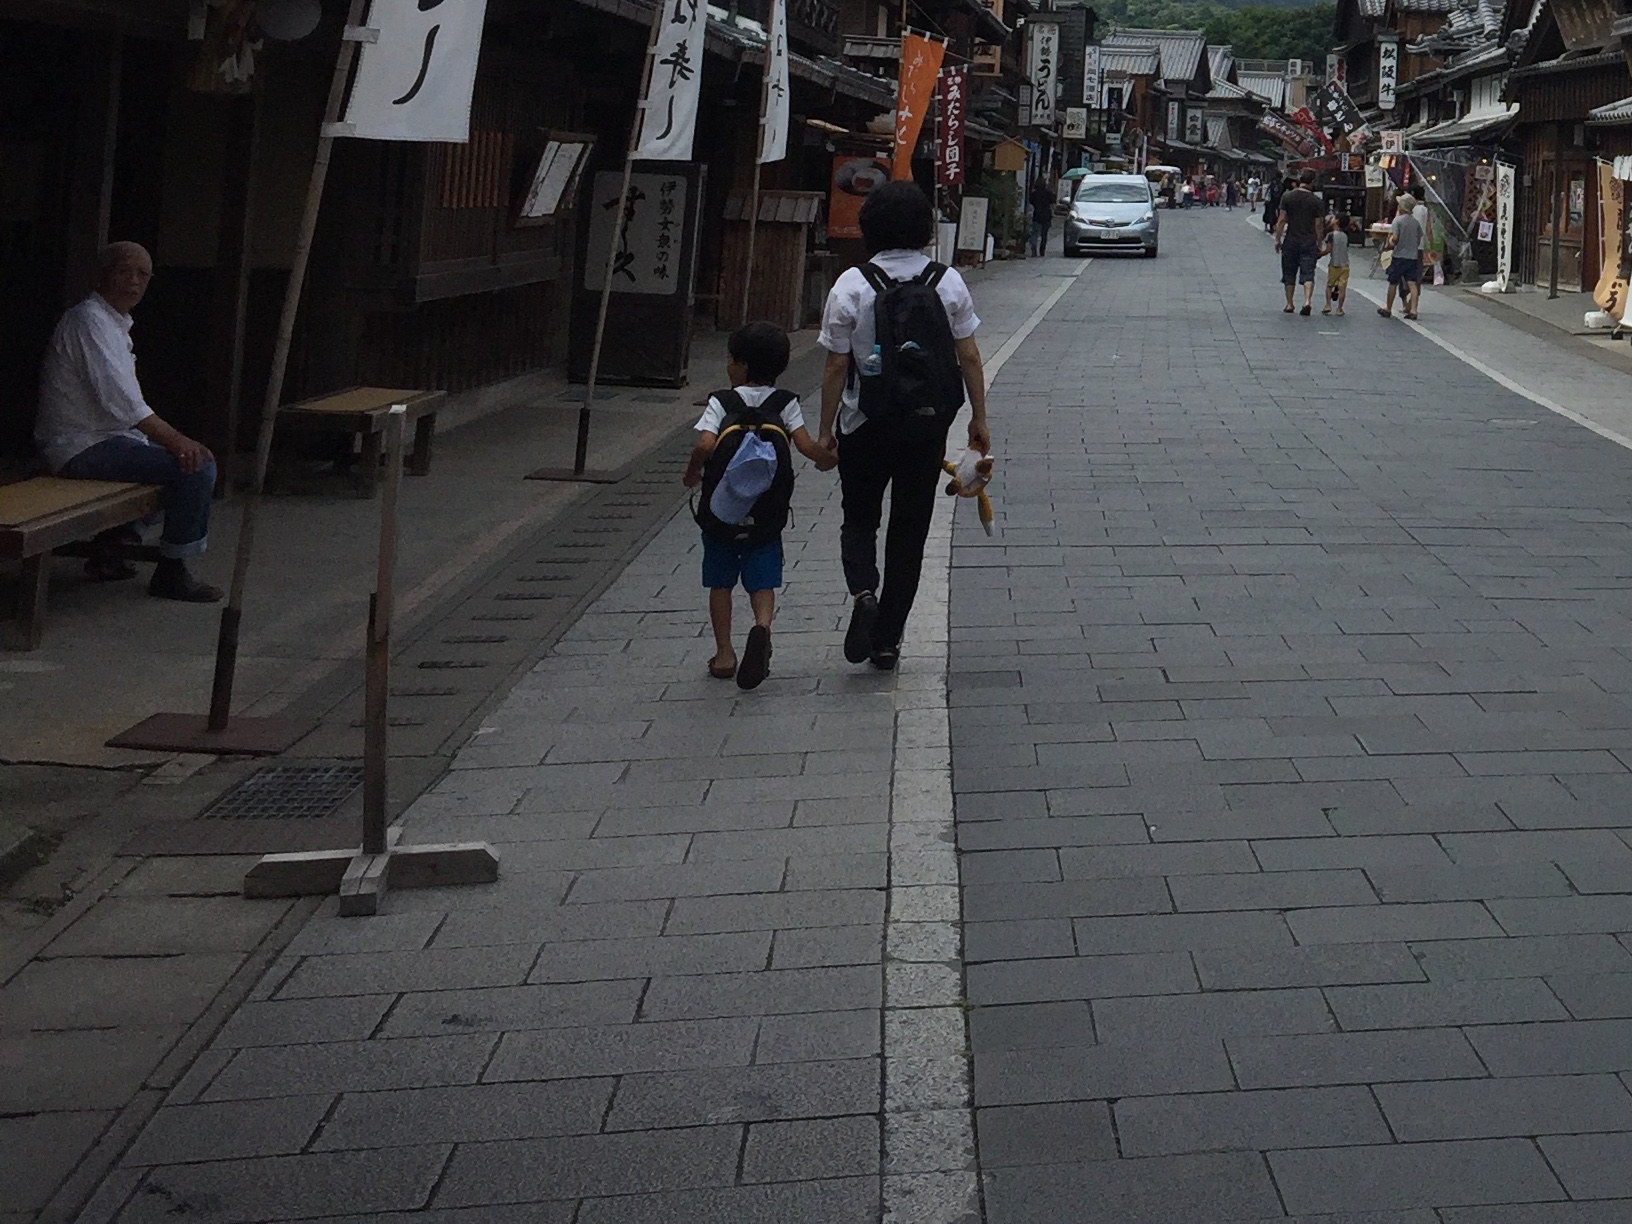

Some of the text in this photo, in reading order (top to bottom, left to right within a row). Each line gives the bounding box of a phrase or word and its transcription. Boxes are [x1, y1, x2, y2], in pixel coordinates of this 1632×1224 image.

[1381, 47, 1396, 96] 松阪牛
[944, 84, 961, 180] みたらし団子
